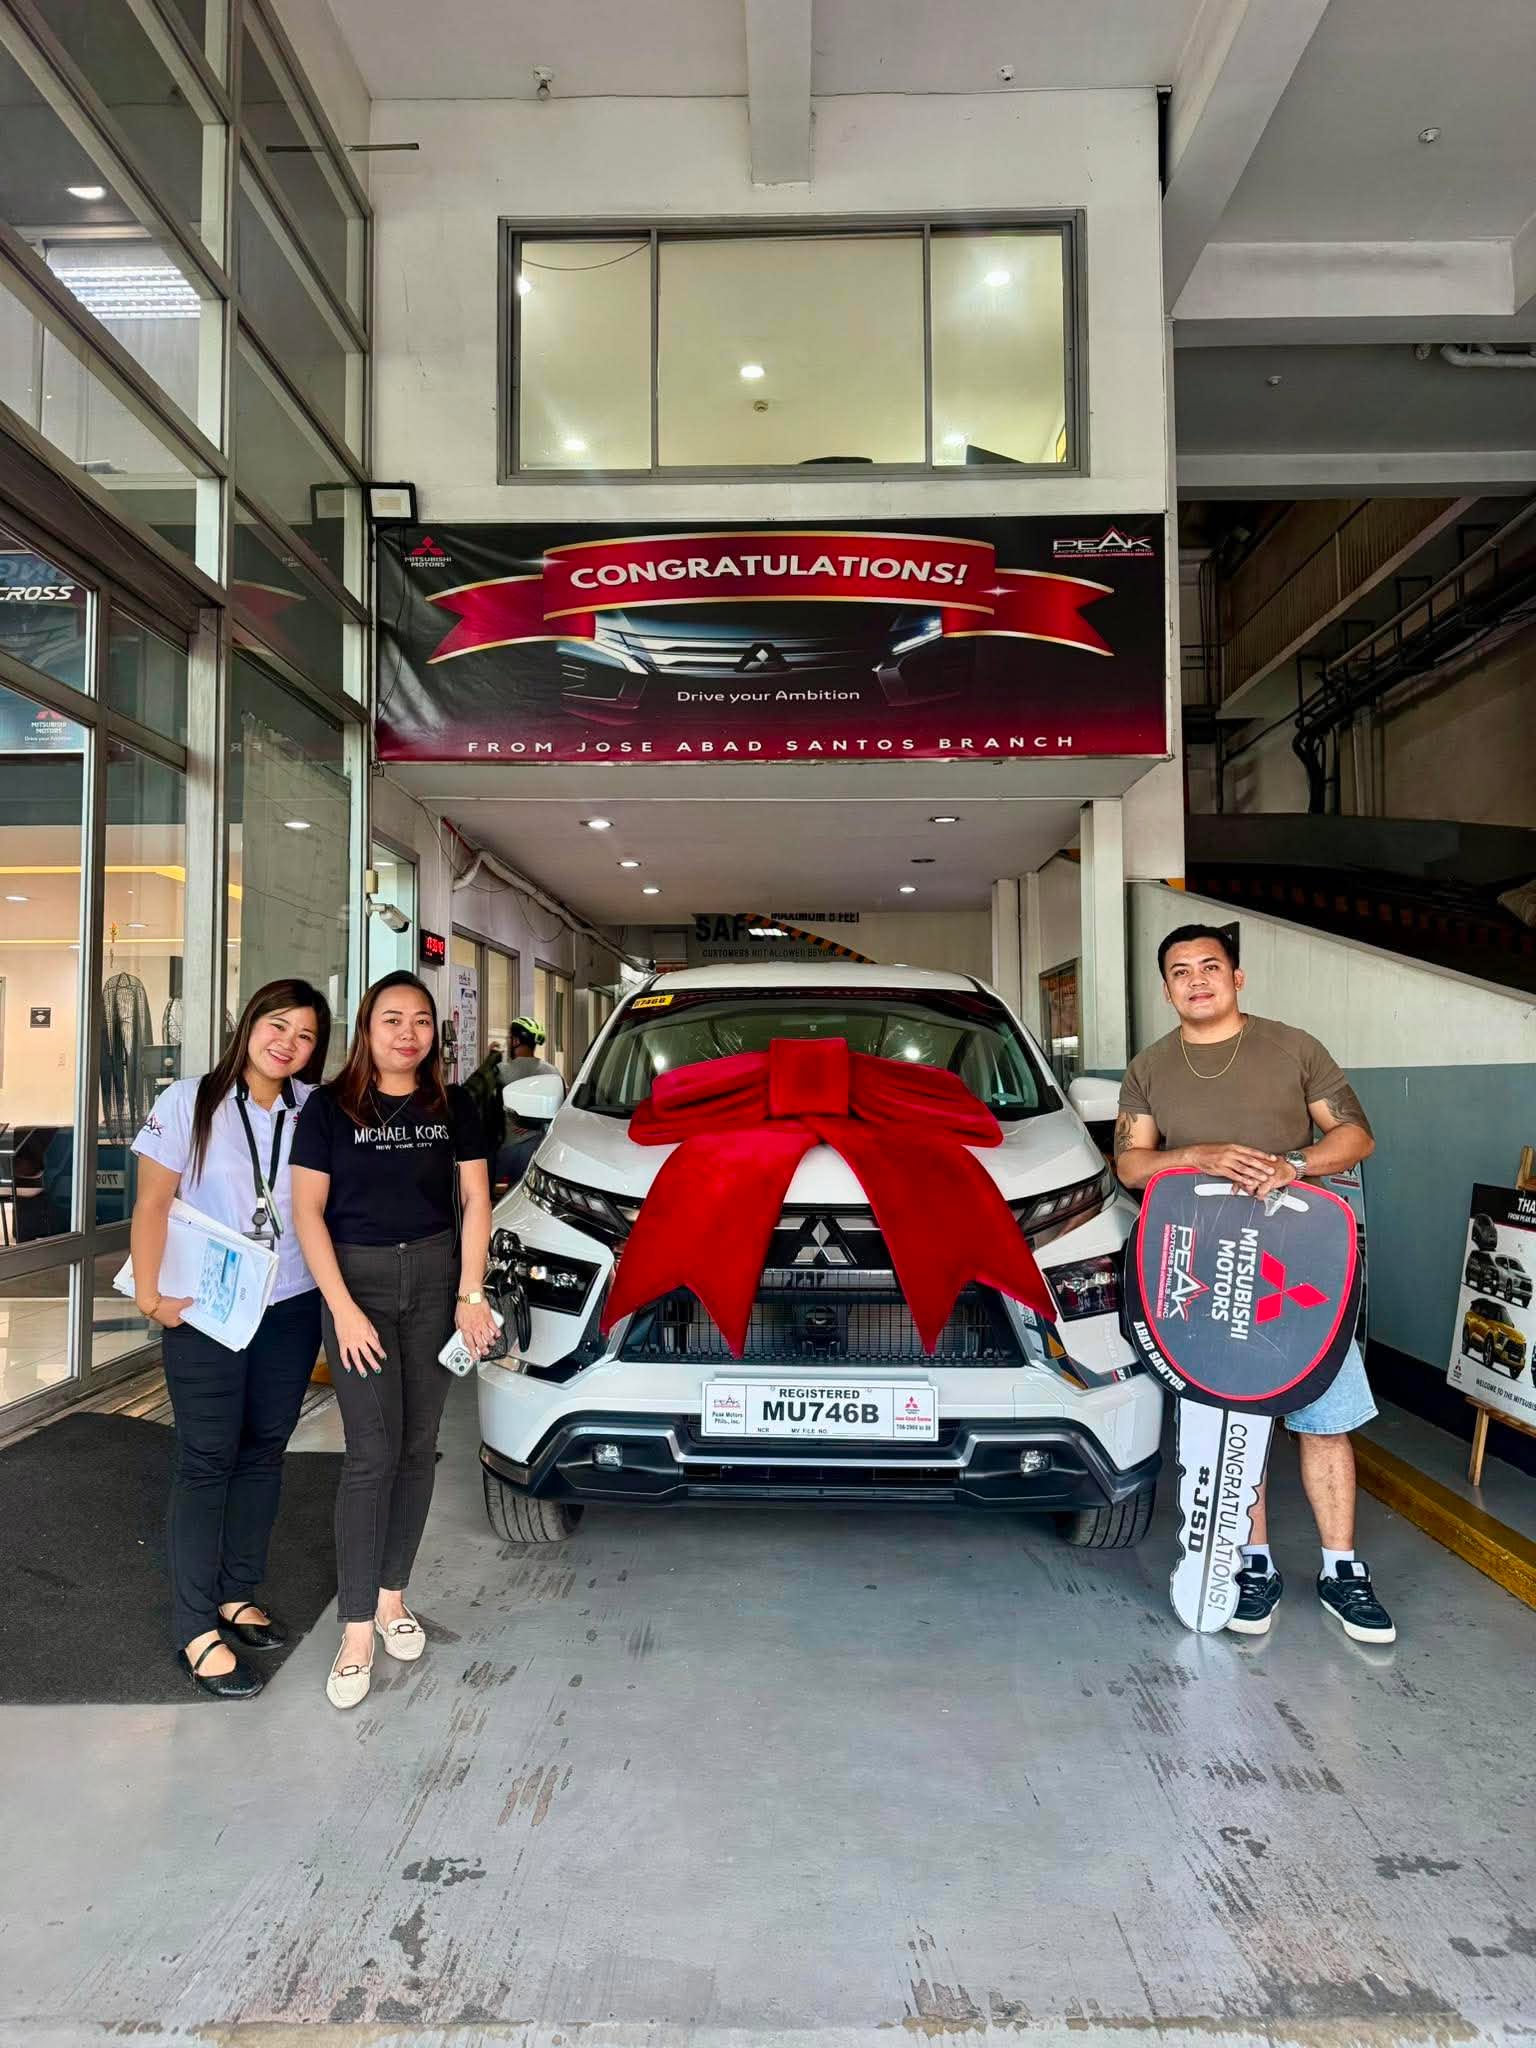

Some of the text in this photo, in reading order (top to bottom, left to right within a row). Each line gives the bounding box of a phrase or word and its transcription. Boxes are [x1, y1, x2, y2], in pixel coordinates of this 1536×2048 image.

[1053, 531, 1152, 550] PEAK
[569, 554, 969, 590] CONGRATULATIONS!
[677, 690, 860, 704] Drive your Ambition
[468, 736, 1073, 753] FROM JOSE ABAD SANTOS BRANCH
[354, 1124, 449, 1144] MICHAEL KORS
[1166, 1224, 1177, 1266] MOTORS
[1169, 1225, 1201, 1320] PEAK
[1211, 1239, 1236, 1321] MOTORS
[1230, 1227, 1259, 1340] MITSUBISHI
[1133, 1320, 1155, 1351] ABAD
[1148, 1351, 1187, 1391] SANTOS
[779, 1388, 860, 1399] REGISTERED
[1476, 1378, 1497, 1393] WELCOME
[1504, 1391, 1513, 1400] THE
[763, 1401, 880, 1424] MU746B
[1188, 1465, 1211, 1553] #JSD
[1207, 1423, 1248, 1612] CONGRATULATIONS!
